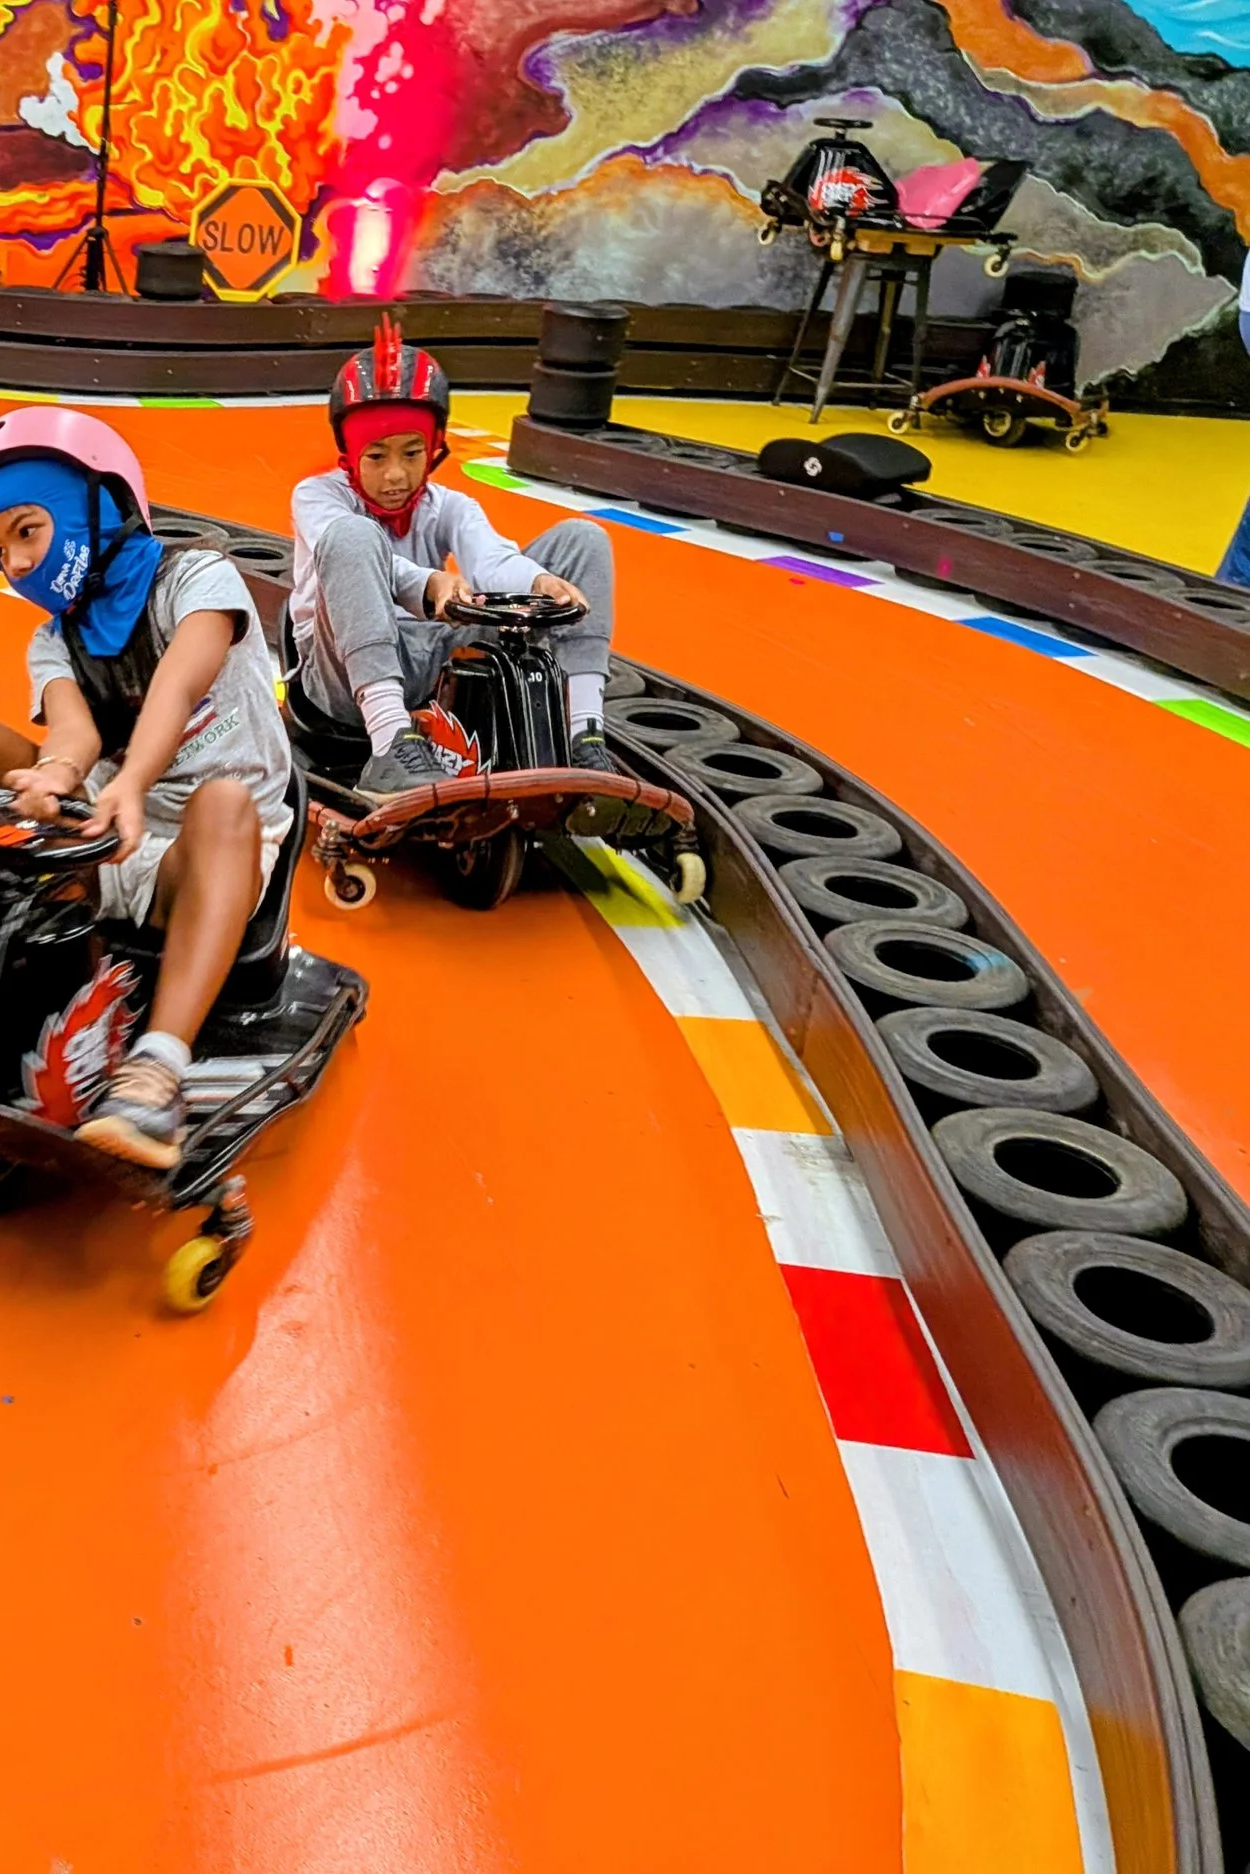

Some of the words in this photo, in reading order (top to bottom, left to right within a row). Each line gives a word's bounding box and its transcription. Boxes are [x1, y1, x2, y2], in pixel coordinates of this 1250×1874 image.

[203, 221, 284, 255] SLOW
[174, 715, 240, 767] ETWORK
[431, 741, 475, 770] AZY
